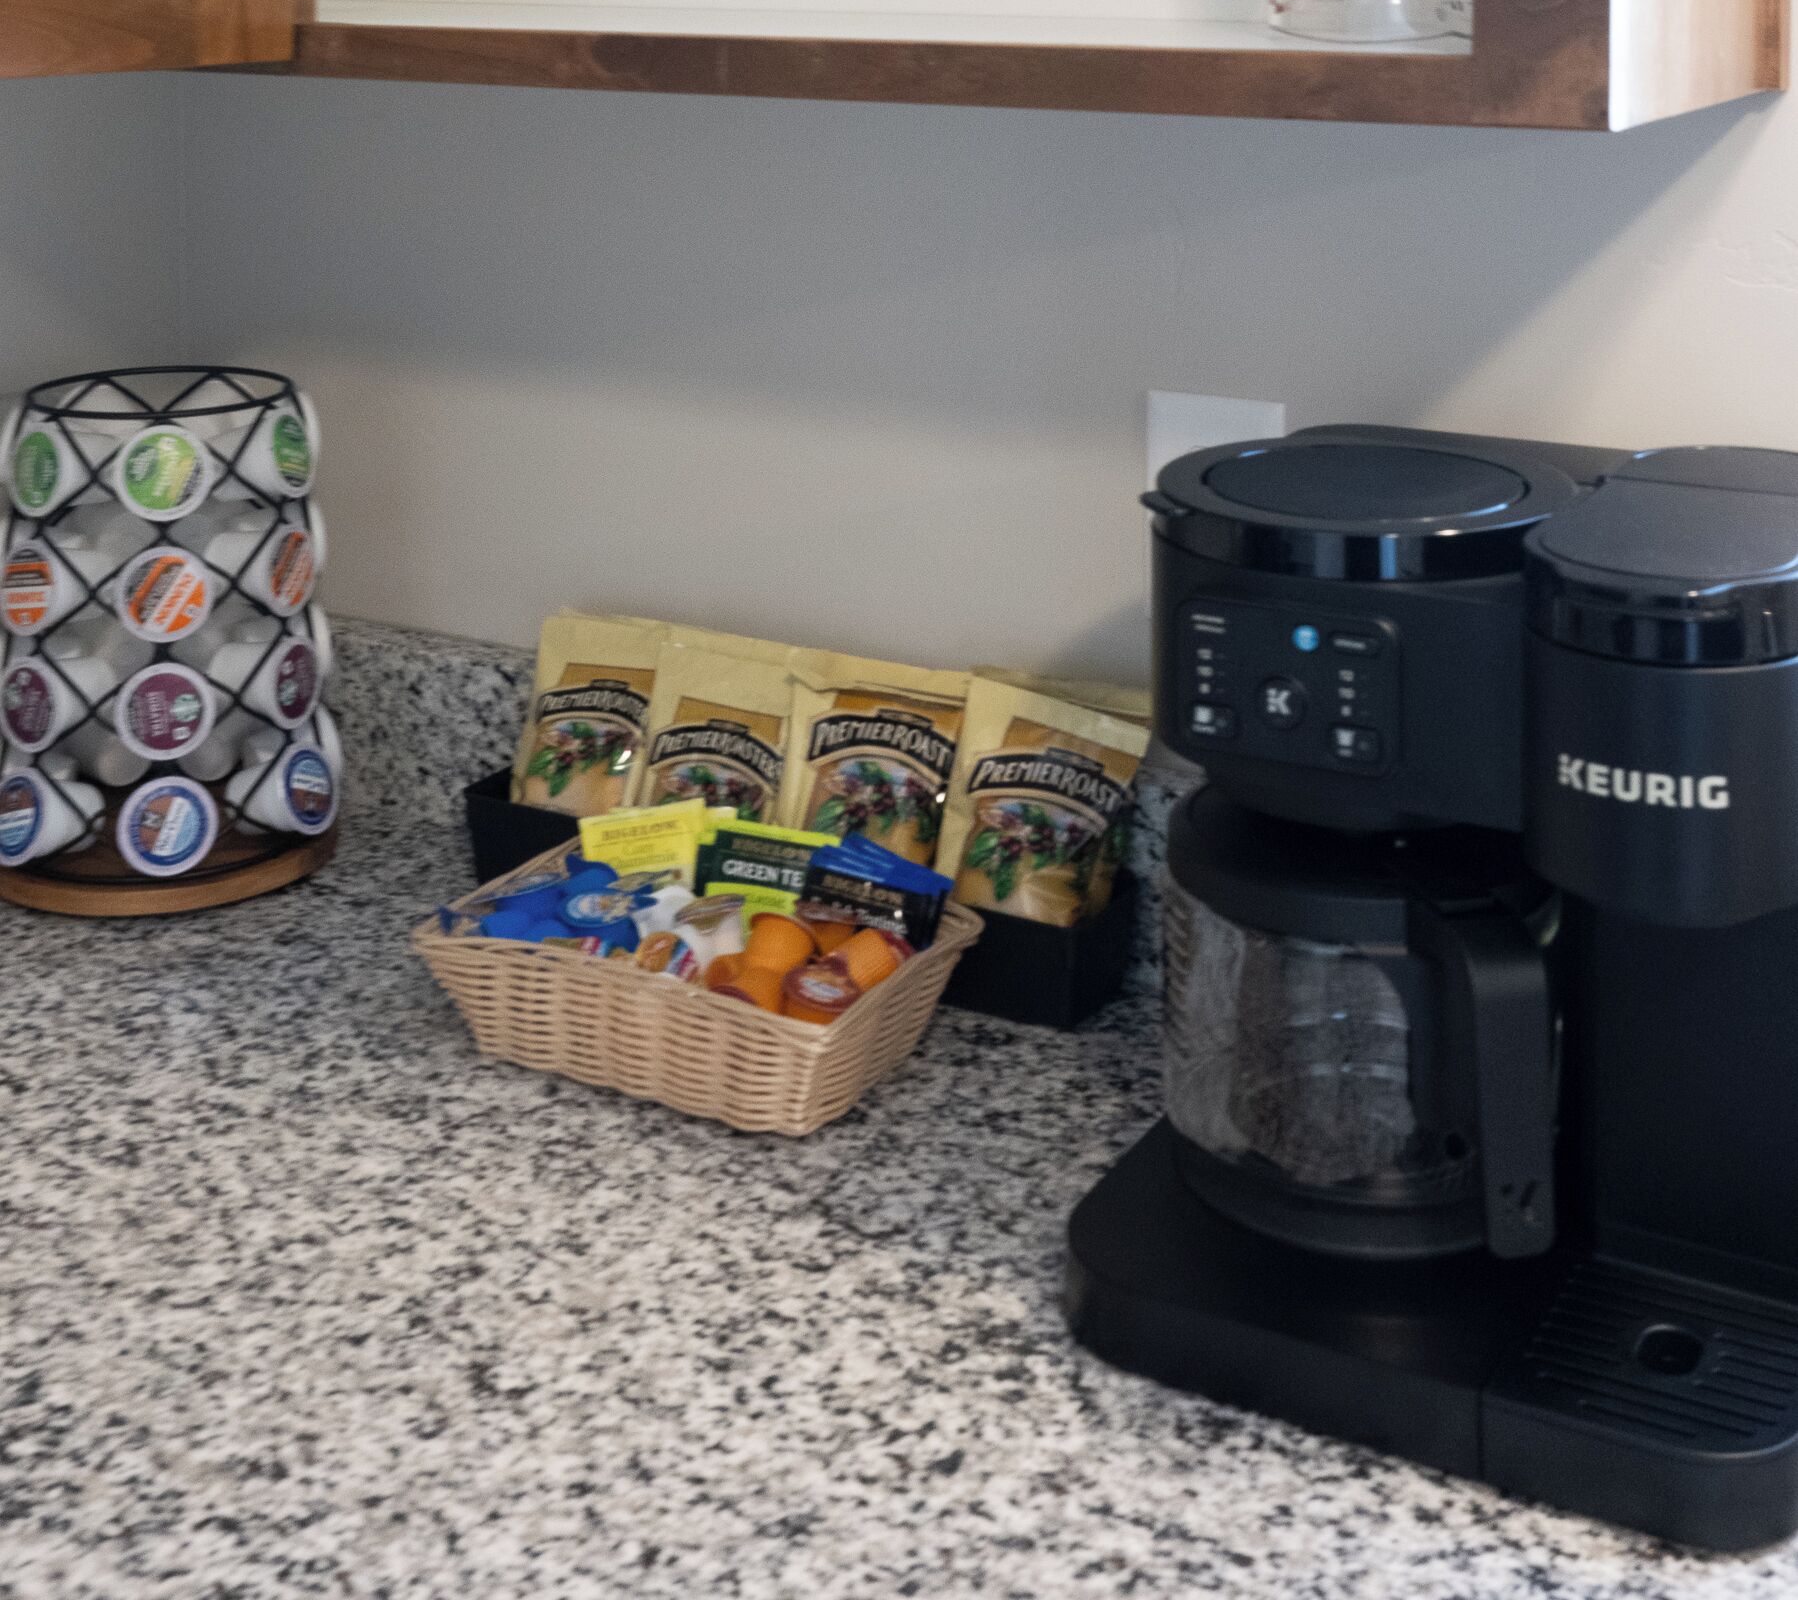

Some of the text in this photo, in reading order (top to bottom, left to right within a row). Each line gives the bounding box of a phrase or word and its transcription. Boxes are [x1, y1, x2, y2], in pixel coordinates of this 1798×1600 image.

[1267, 687, 1292, 715] K
[1557, 753, 1730, 810] KEURIG
[722, 858, 805, 888] GREEN TE
